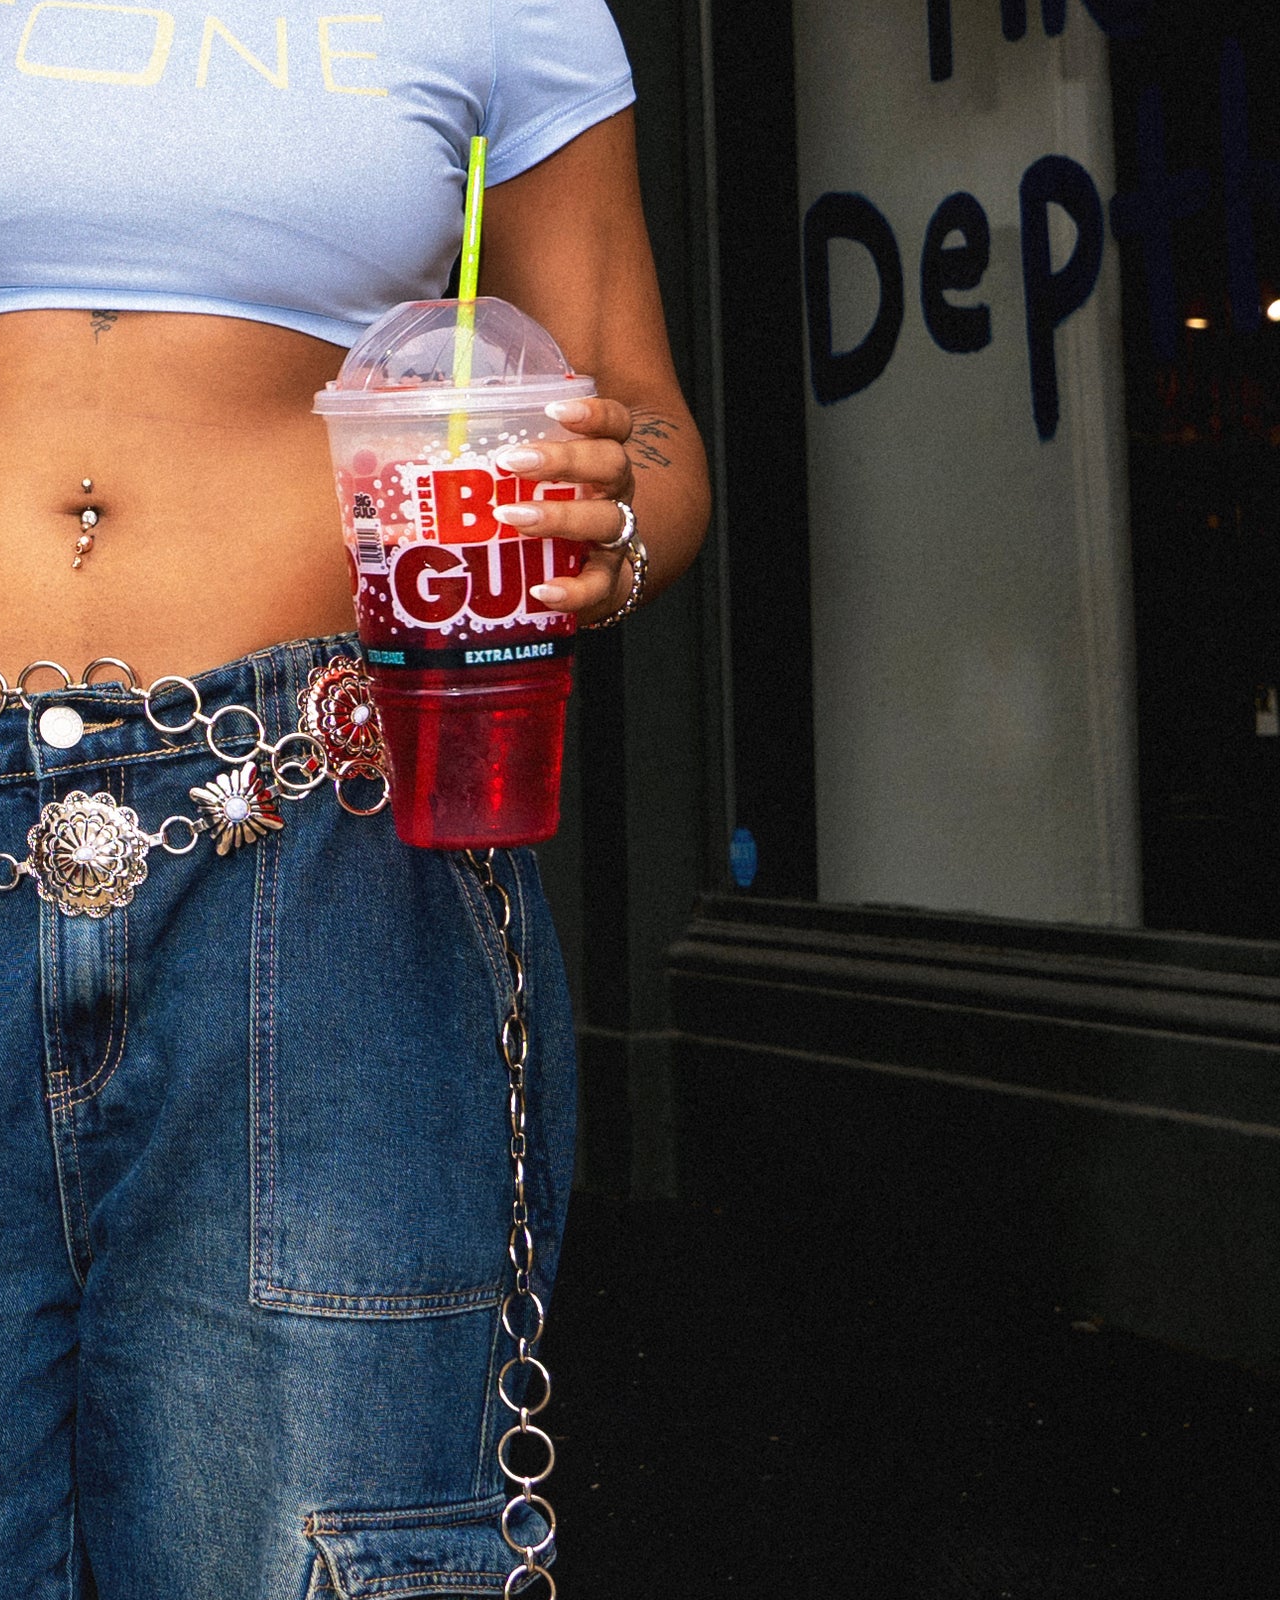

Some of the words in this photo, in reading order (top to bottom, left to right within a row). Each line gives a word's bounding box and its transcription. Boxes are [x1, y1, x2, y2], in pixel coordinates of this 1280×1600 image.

[416, 475, 436, 541] SUPER
[465, 648, 513, 664] EXTRA
[515, 643, 554, 659] LARGE
